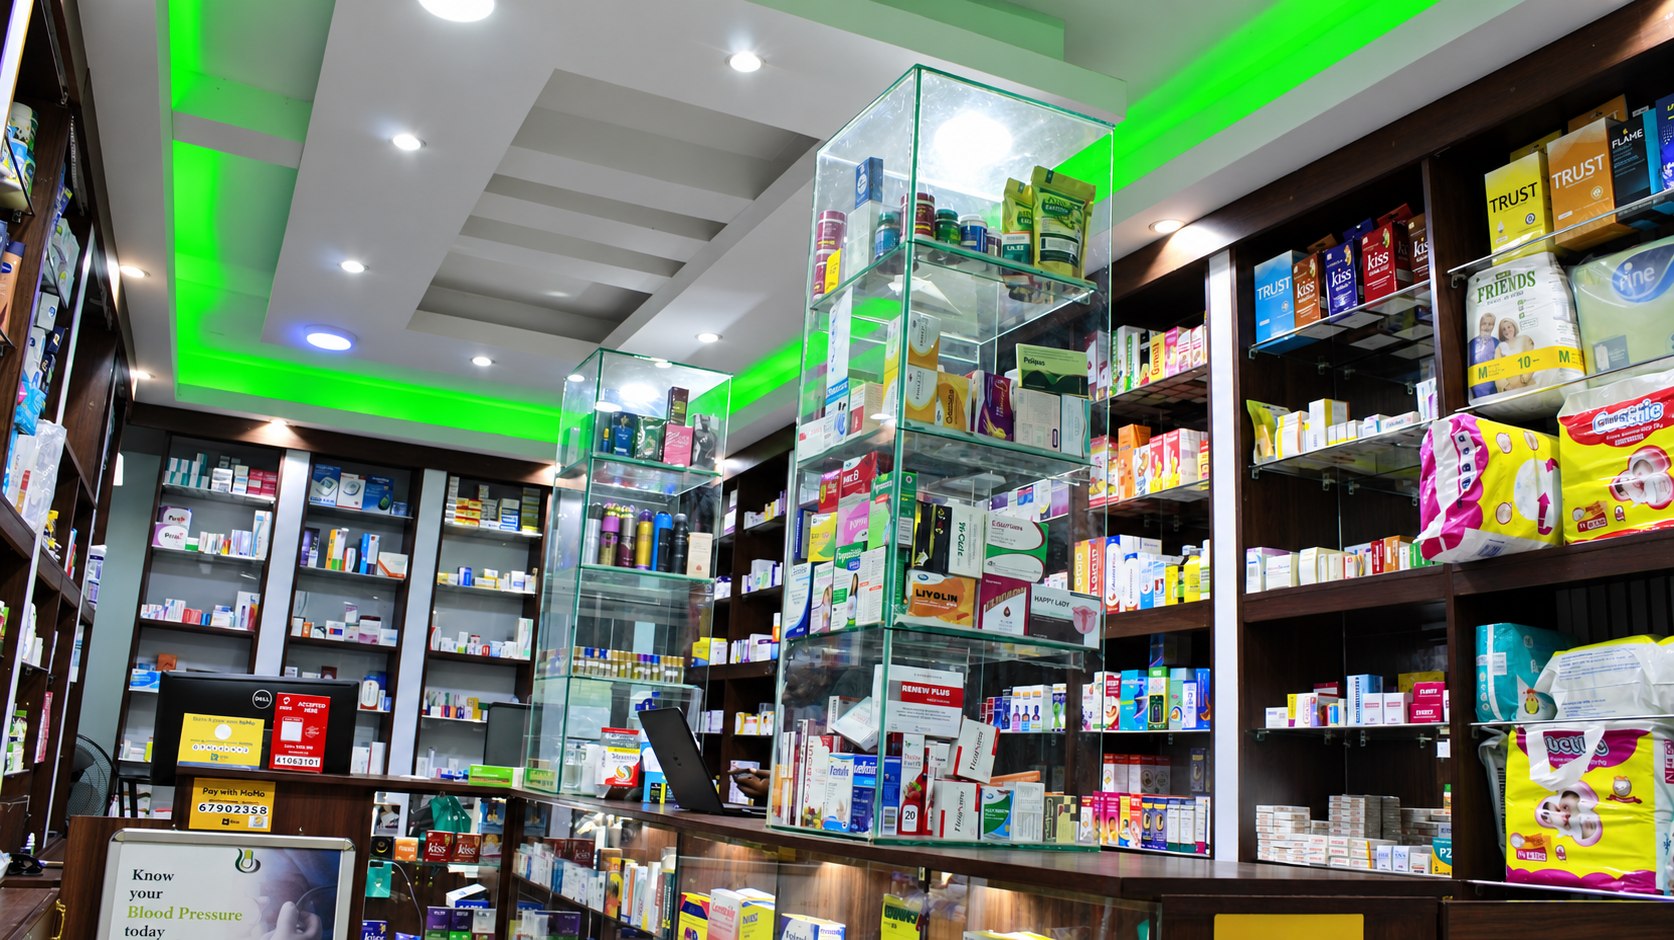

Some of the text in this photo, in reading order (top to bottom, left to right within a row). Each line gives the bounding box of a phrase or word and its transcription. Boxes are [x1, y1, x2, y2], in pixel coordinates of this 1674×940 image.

[1611, 128, 1644, 149] FLAME
[1552, 153, 1606, 189] TRUST
[1489, 182, 1538, 214] TRUST
[1413, 238, 1430, 258] kis
[1367, 251, 1389, 271] kiss
[1331, 268, 1352, 288] kiss
[1619, 261, 1656, 291] fine
[1256, 276, 1292, 300] TRUST
[1296, 279, 1315, 299] kiss
[1477, 270, 1536, 304] FRIENDS
[1517, 355, 1531, 370] 10
[1558, 349, 1571, 364] M
[1478, 366, 1488, 380] M
[915, 588, 958, 604] LIVOLIN
[1034, 595, 1054, 606] HAPPY
[1054, 599, 1070, 609] LADY
[902, 684, 951, 697] RENEW PLUS
[202, 786, 266, 798] Pay with MoMo
[198, 803, 268, 815] 67902358
[904, 810, 916, 820] 20
[428, 842, 447, 854] kiss
[457, 843, 476, 855] kiss
[131, 868, 175, 882] Know
[129, 888, 164, 902] your
[127, 905, 243, 922] Blood Pressure
[124, 924, 166, 940] today
